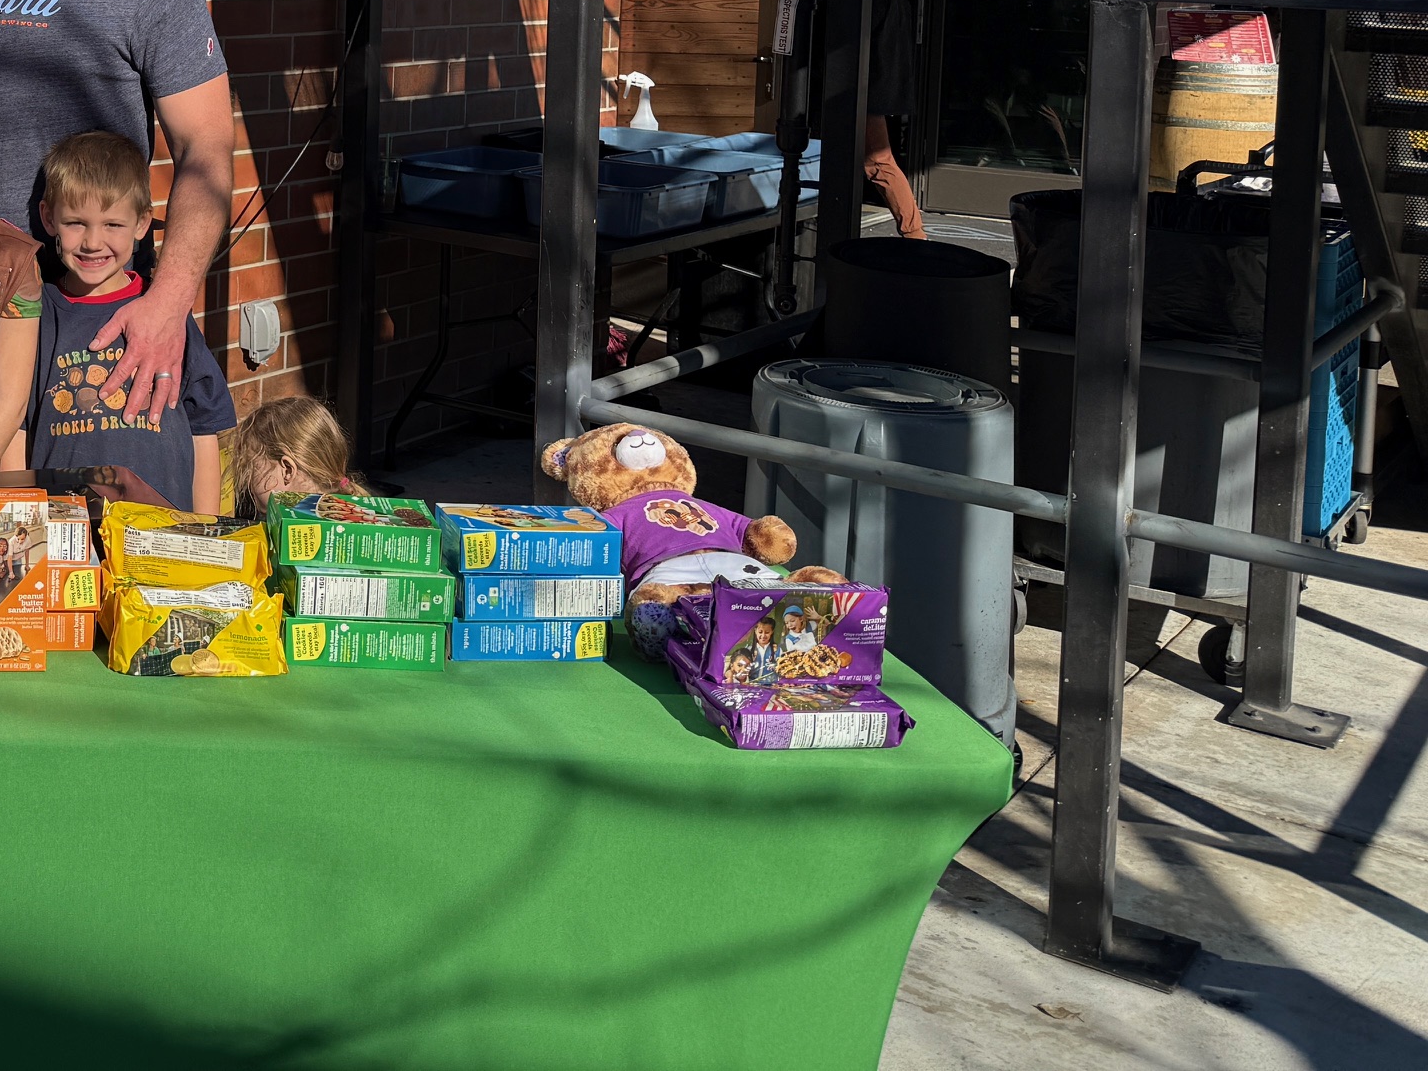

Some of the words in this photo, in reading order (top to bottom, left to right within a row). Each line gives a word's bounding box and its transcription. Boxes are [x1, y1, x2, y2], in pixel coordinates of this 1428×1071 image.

[778, 34, 787, 53] TEST
[57, 350, 90, 368] GIRL
[97, 348, 124, 361] SCO
[50, 418, 95, 436] COOKIE
